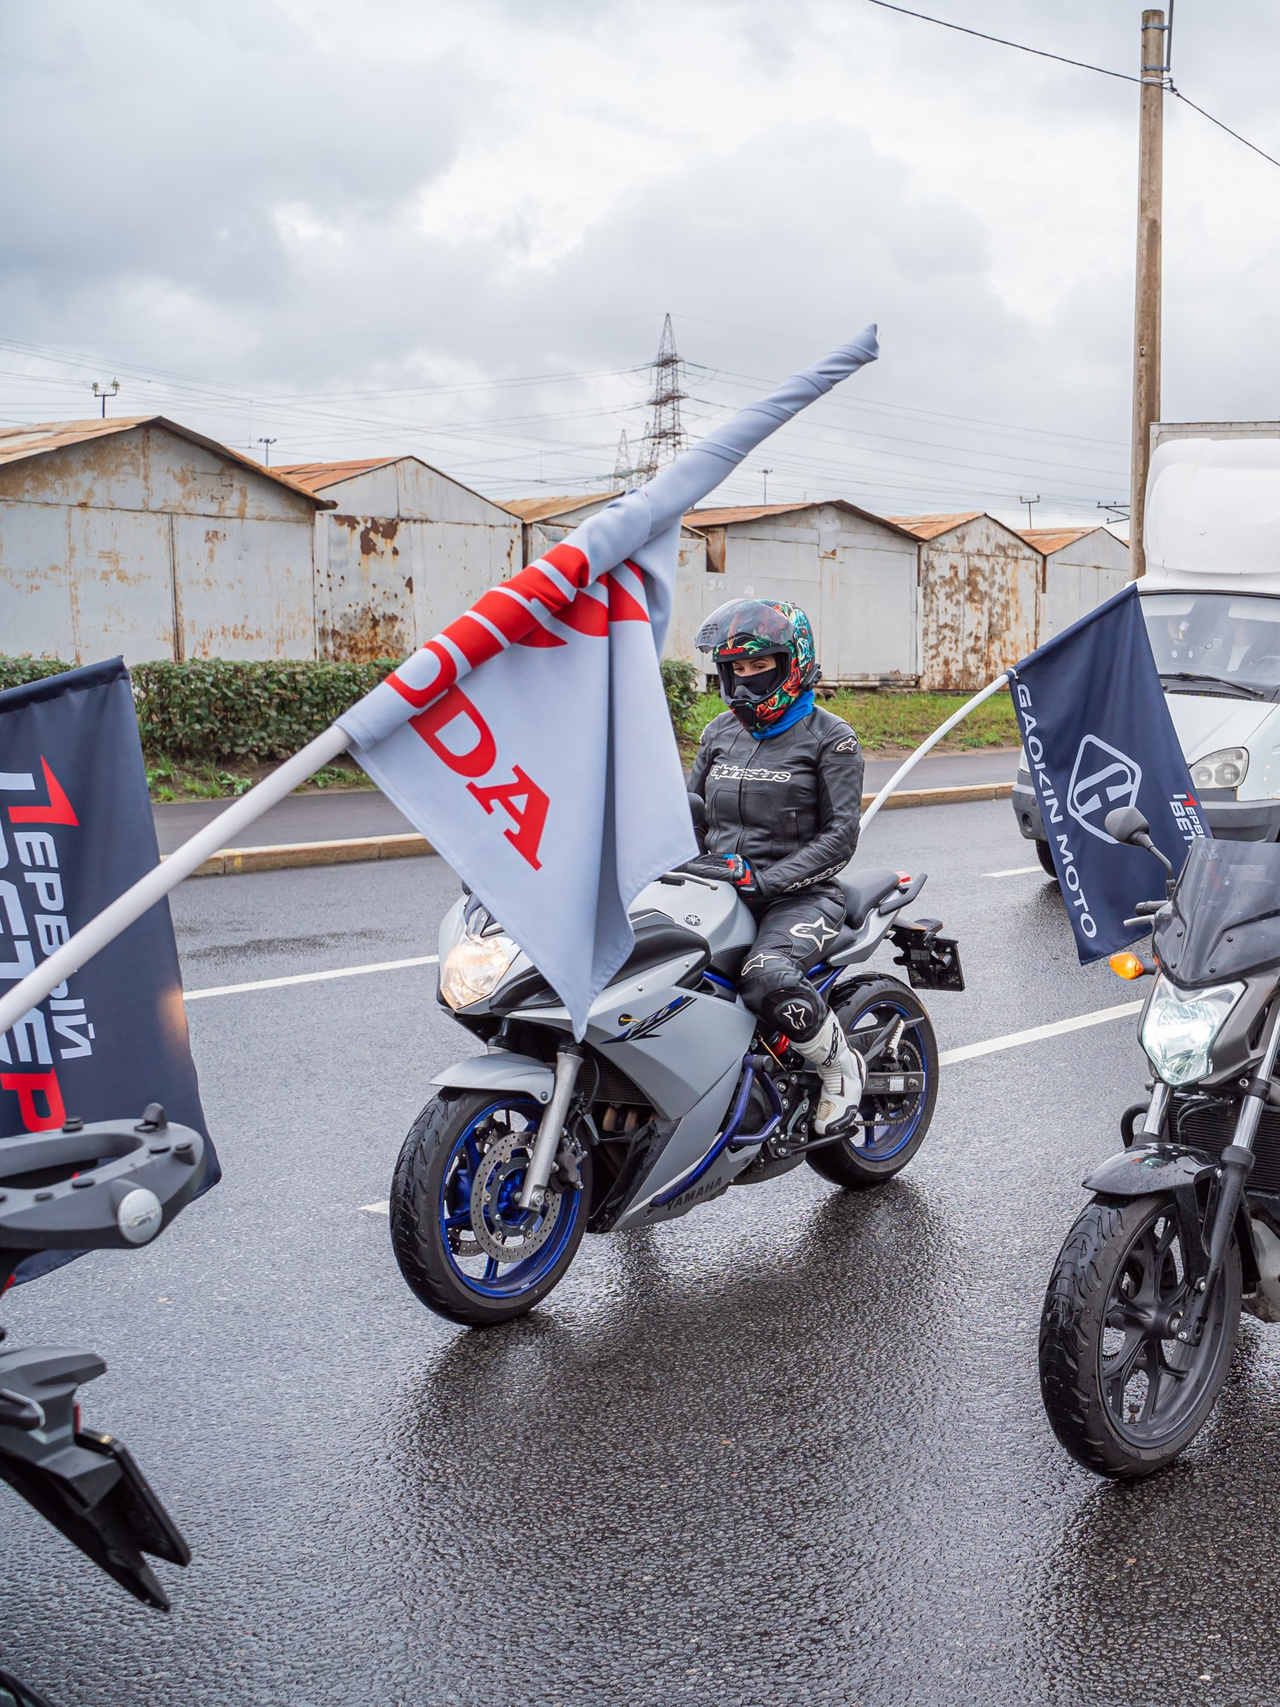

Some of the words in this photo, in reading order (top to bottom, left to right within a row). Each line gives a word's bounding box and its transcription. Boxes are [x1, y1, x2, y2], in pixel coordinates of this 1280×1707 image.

[1017, 683, 1064, 824] GAOKIN
[1055, 834, 1098, 939] MOTO
[667, 1176, 722, 1212] YAMAHA
